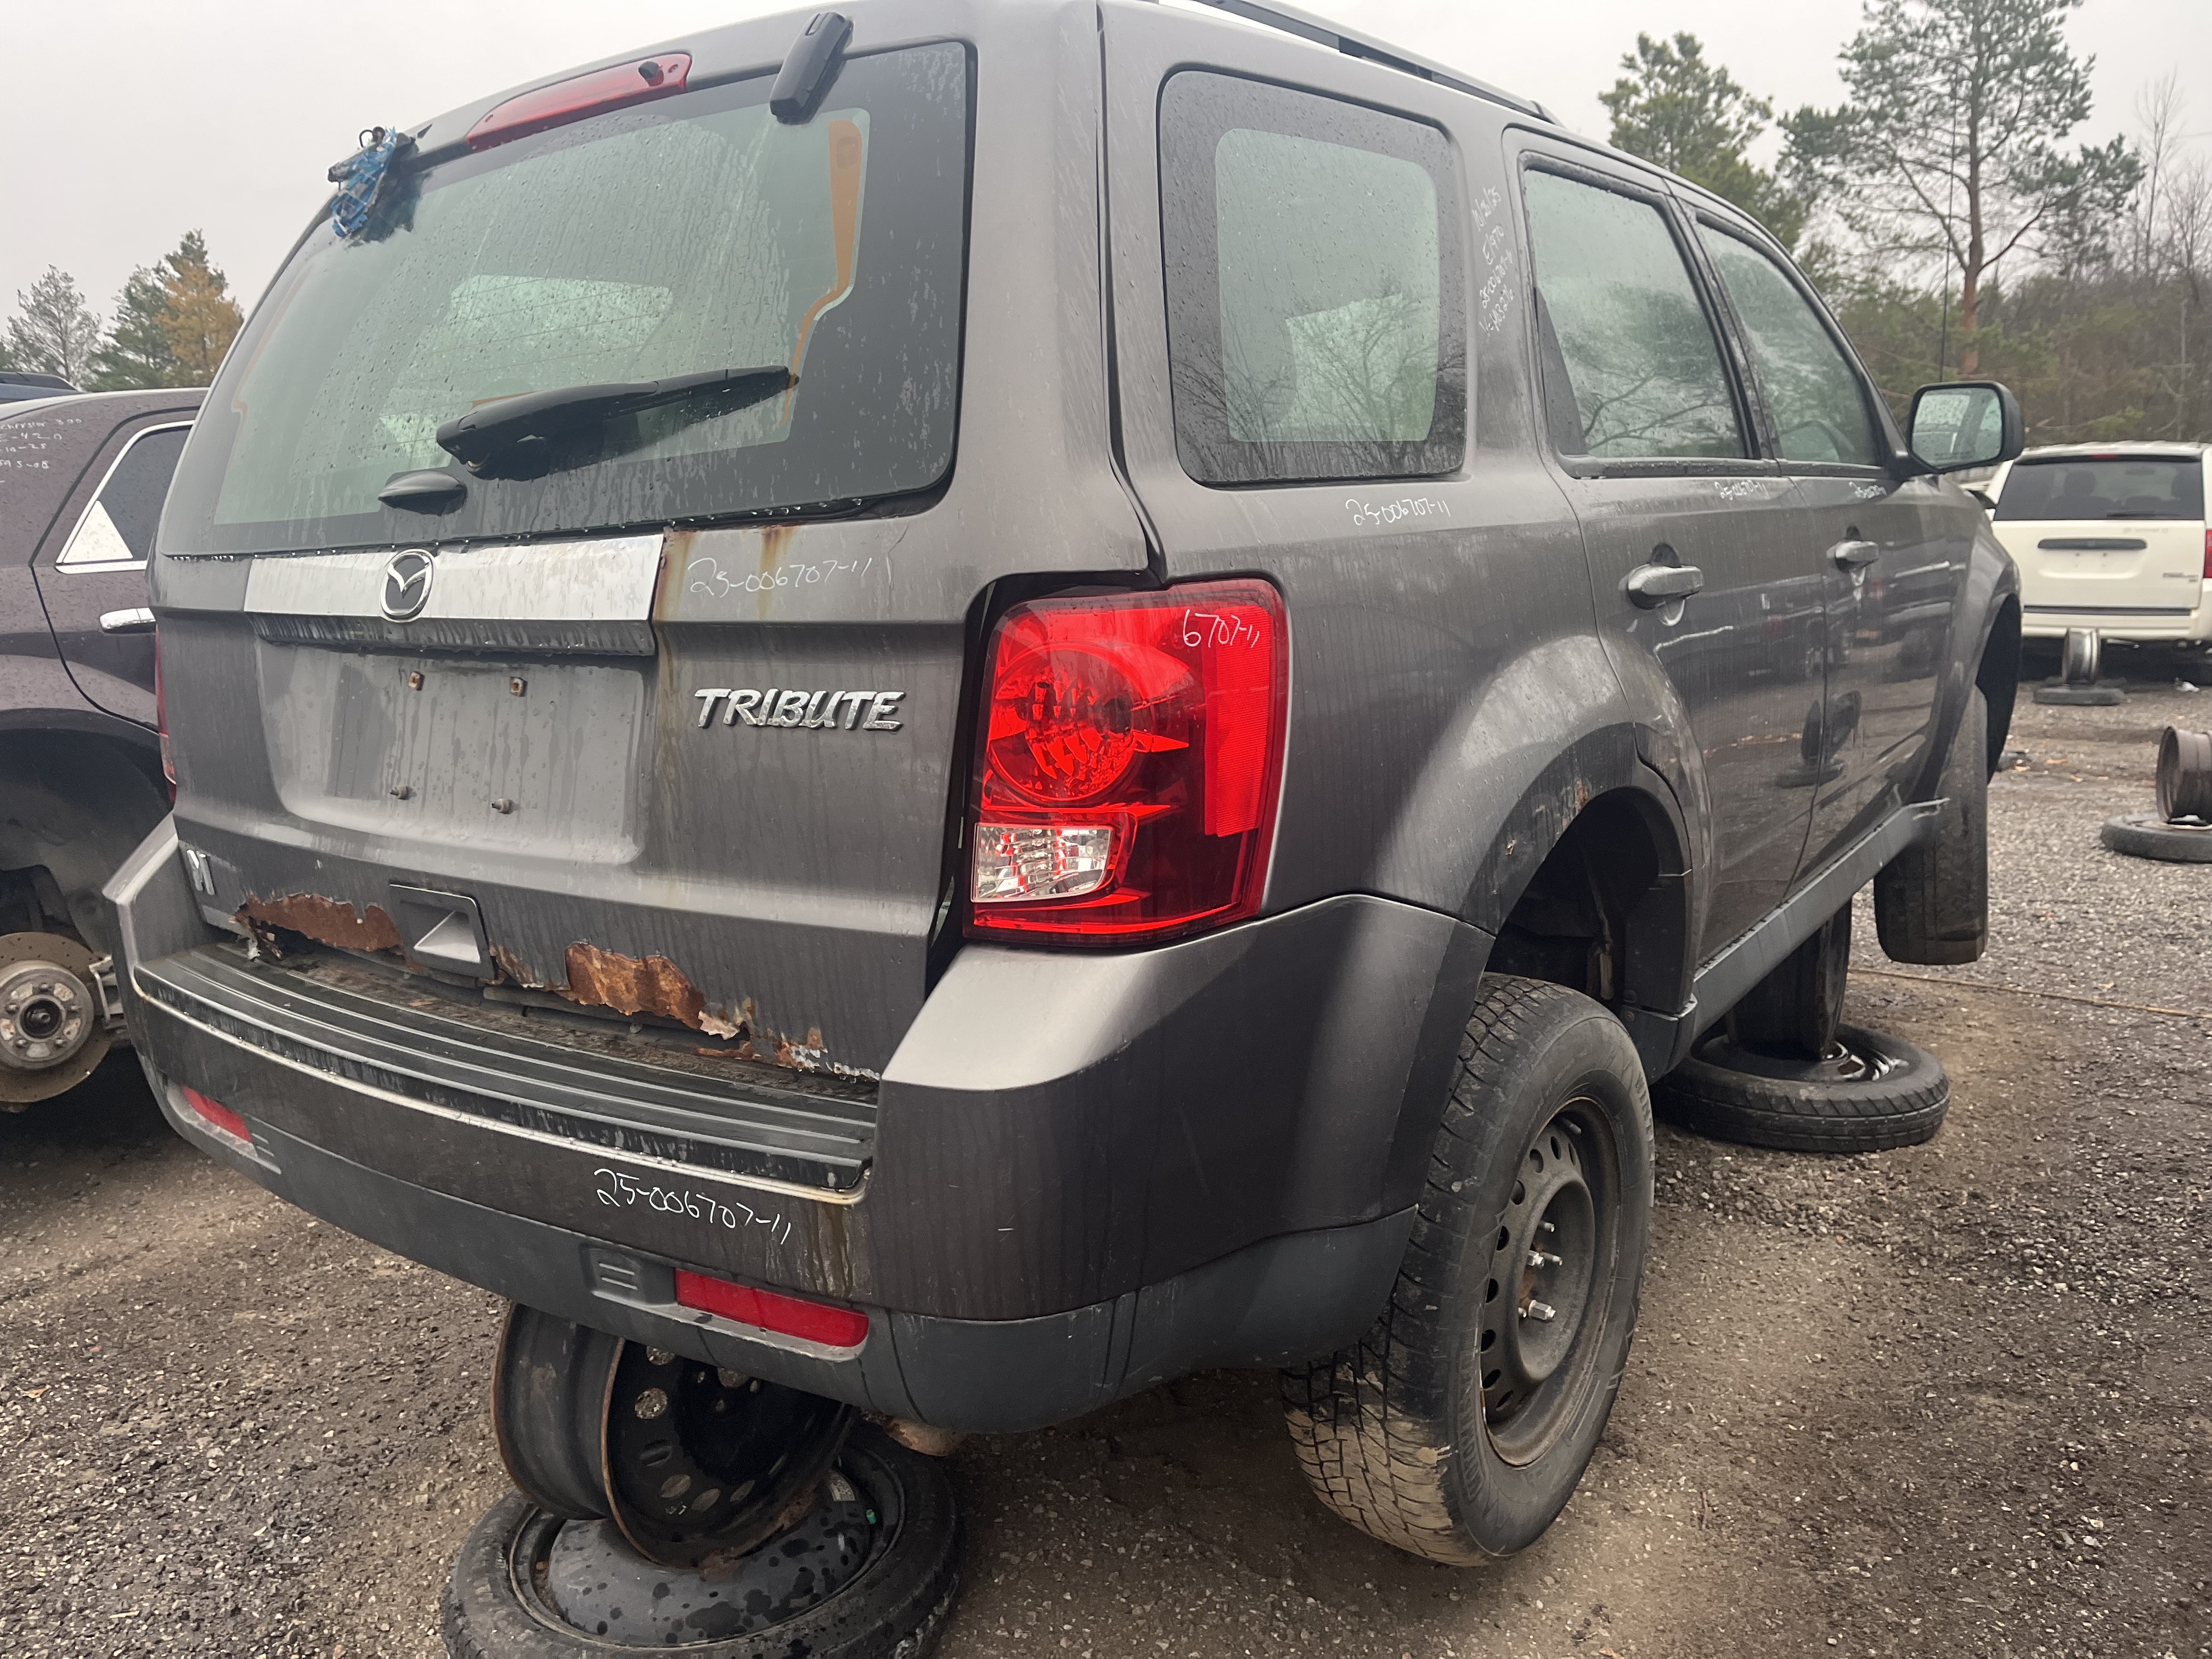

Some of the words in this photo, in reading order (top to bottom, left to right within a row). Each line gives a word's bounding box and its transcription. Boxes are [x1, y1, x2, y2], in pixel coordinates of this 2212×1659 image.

[687, 557, 872, 598] 25-006707-11
[1183, 608, 1260, 649] 6707-11
[694, 687, 906, 732] TRIBUTE
[594, 1168, 792, 1245] 25-006707-11
